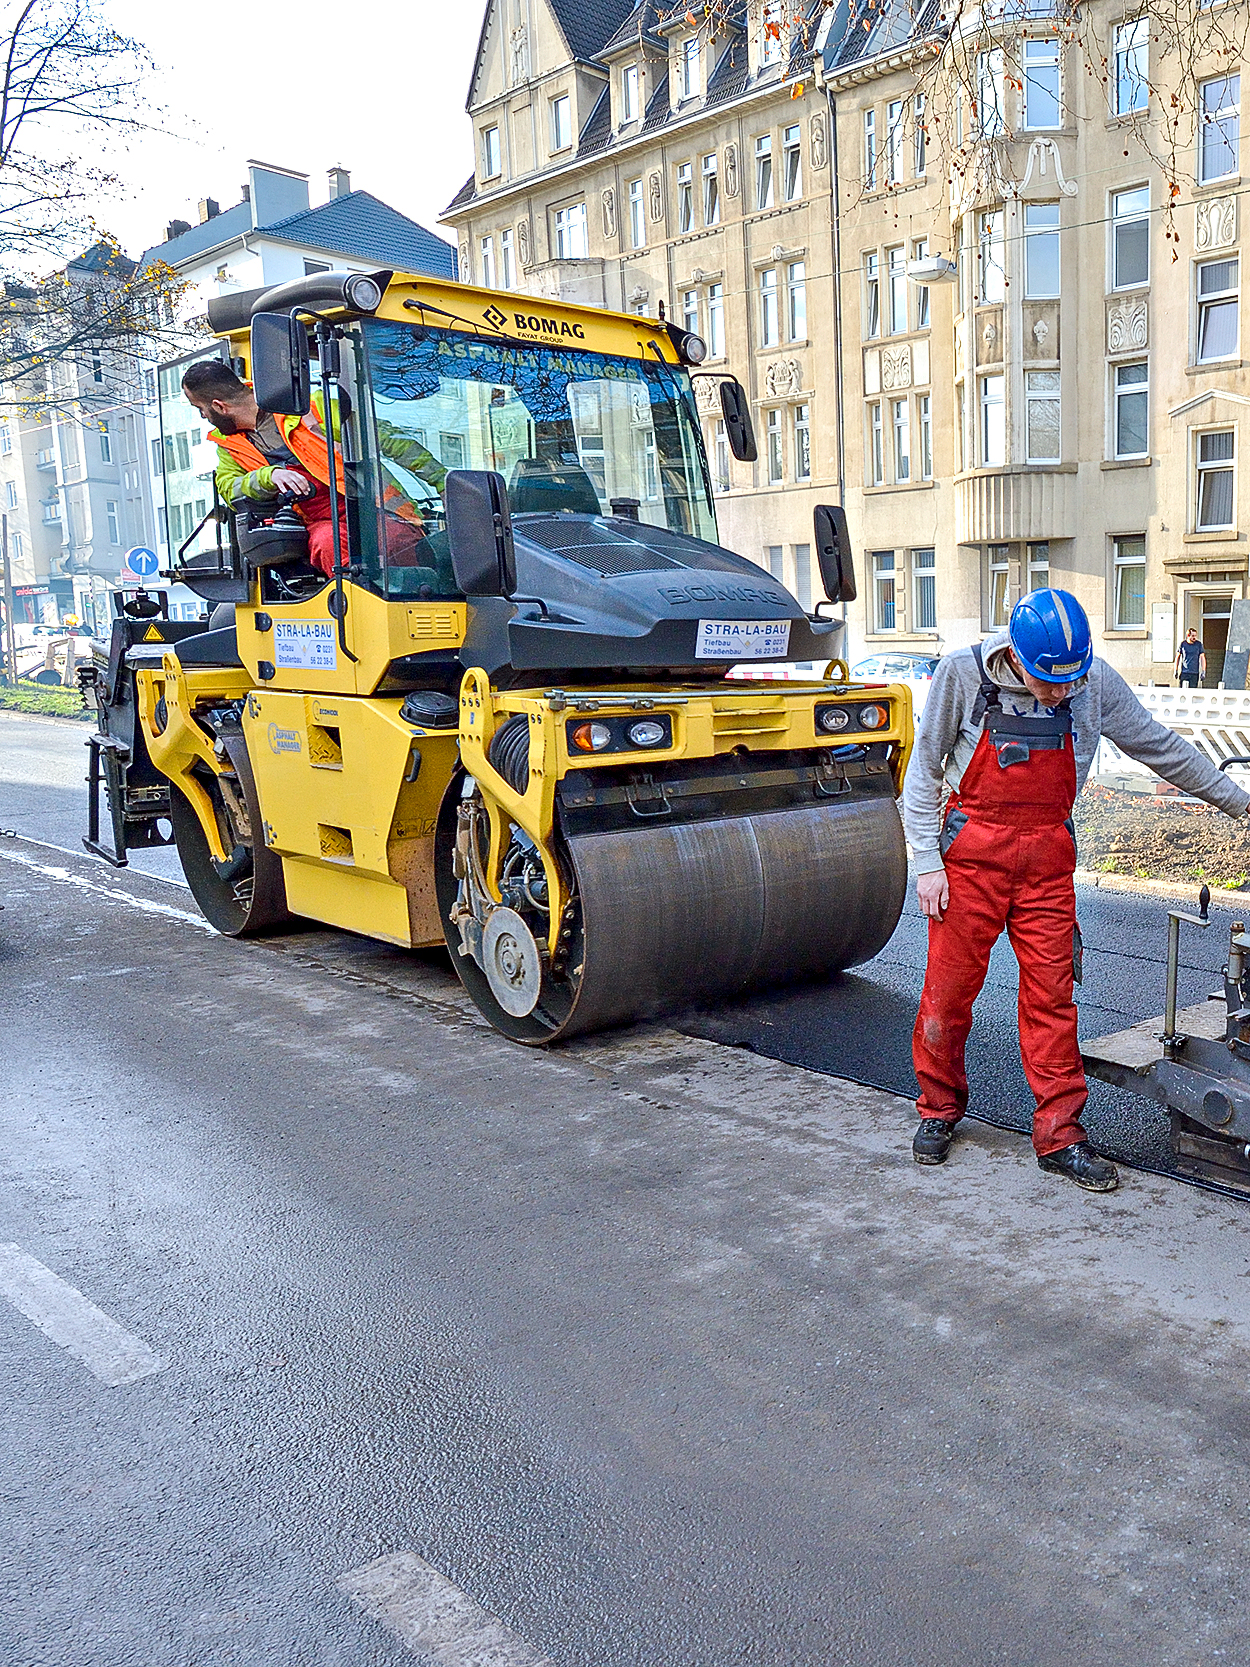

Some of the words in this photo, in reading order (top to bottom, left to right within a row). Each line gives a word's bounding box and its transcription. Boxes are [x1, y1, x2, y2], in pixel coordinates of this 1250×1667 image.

[514, 313, 585, 340] BOMAG
[517, 331, 538, 342] FAYAT
[540, 335, 563, 344] GROUP
[438, 341, 537, 368] ASPHALT
[547, 356, 639, 381] MANAGER
[657, 585, 788, 607] BOMAG
[276, 624, 332, 638] STRA-LA-BAU
[704, 623, 787, 636] STRA-LA-BAU
[277, 643, 294, 652] Tiefbau
[704, 639, 731, 647] Tiefbau
[772, 638, 785, 646] 0231
